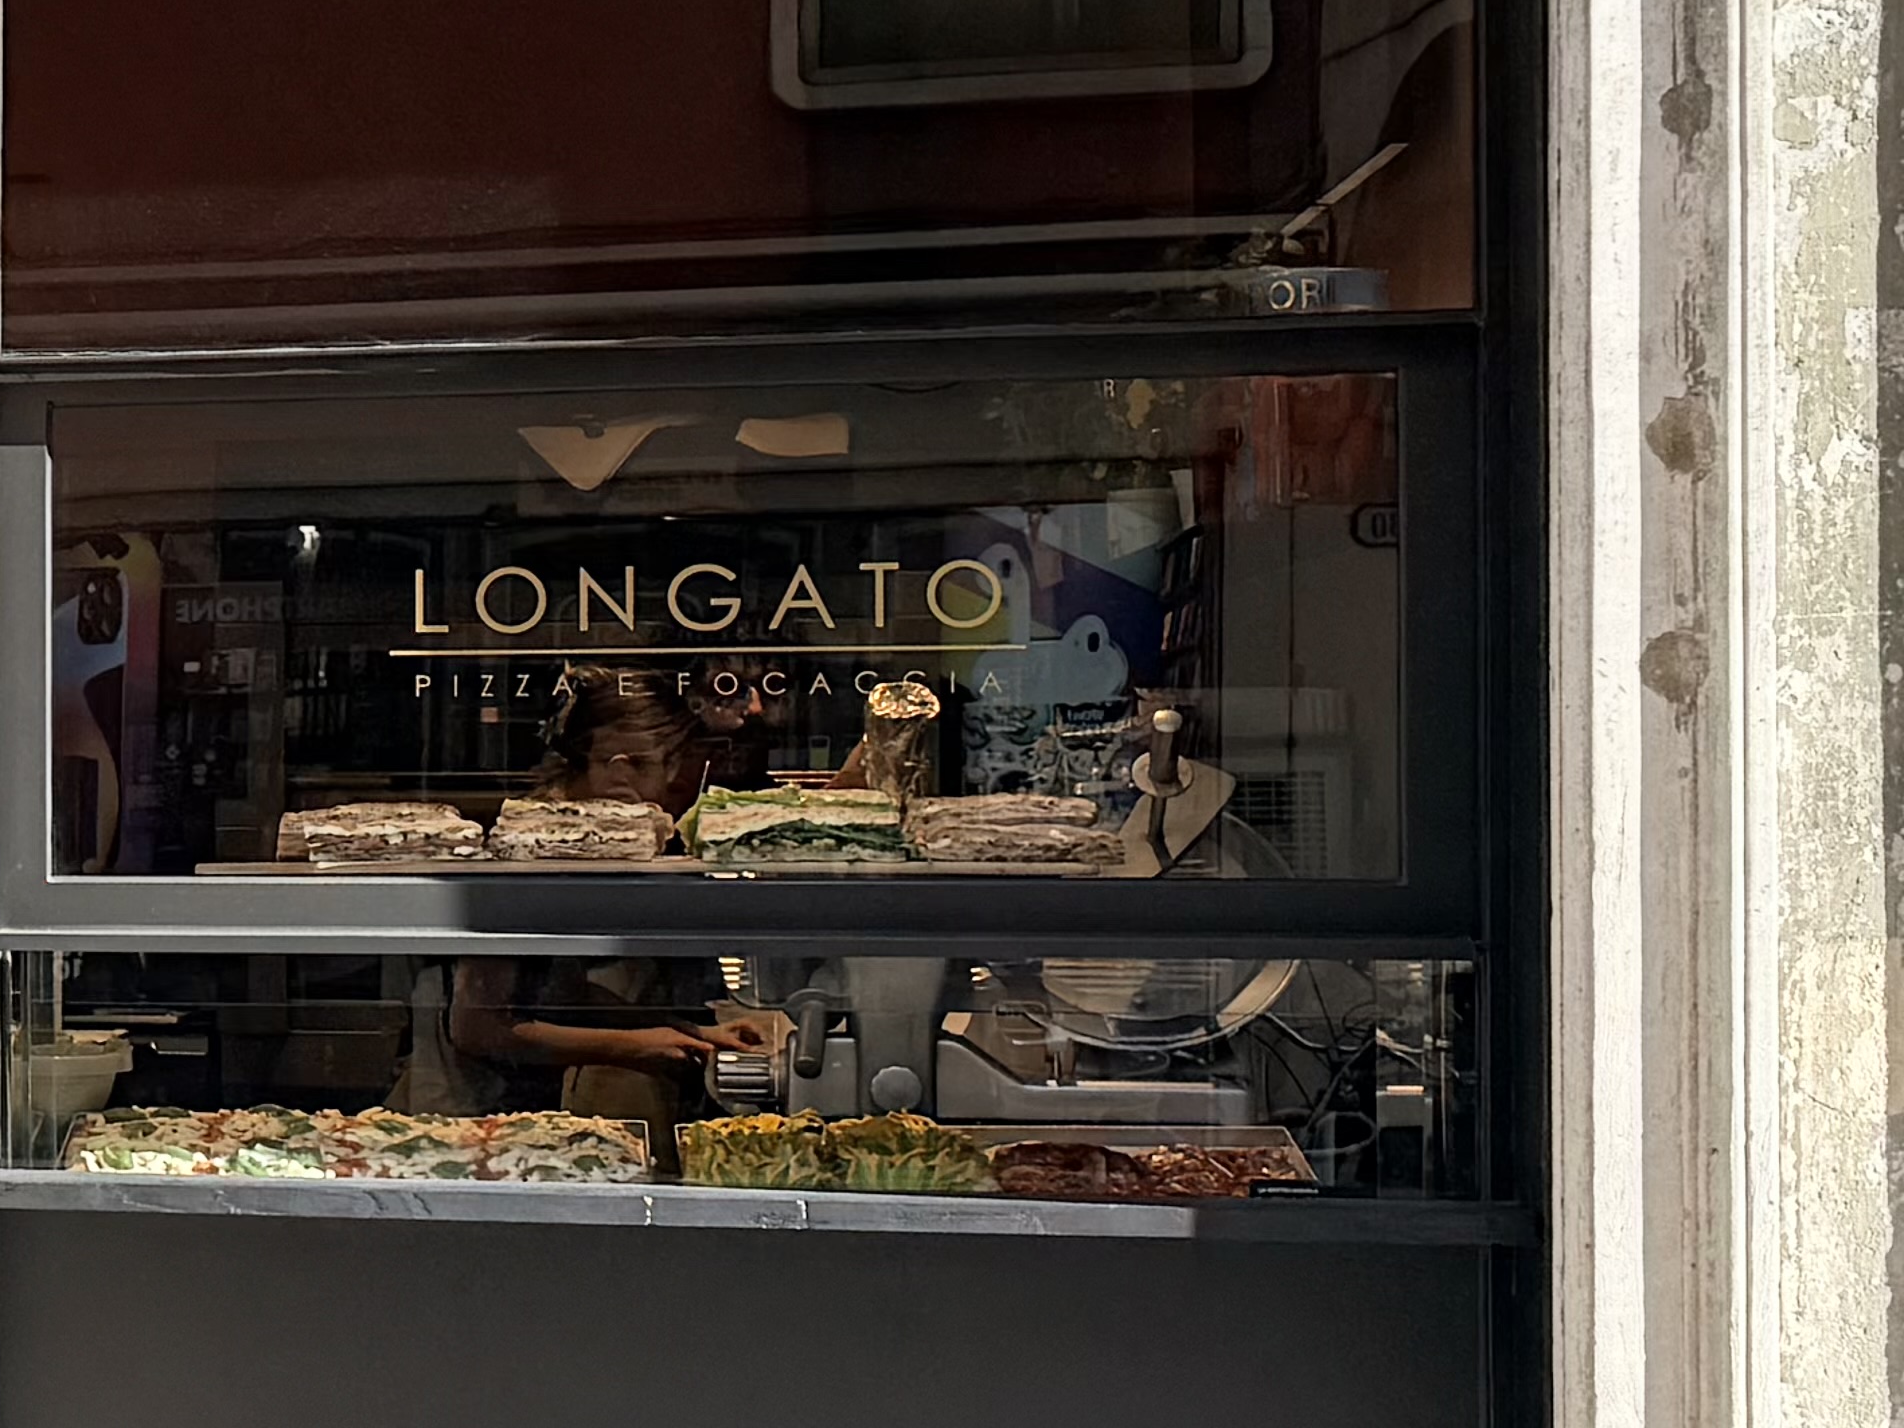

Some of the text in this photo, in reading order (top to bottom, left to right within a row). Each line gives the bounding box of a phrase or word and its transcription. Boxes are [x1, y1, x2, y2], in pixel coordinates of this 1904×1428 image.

[414, 558, 1004, 635] LONGATO
[415, 673, 573, 698] PIZZA
[618, 672, 633, 696] E
